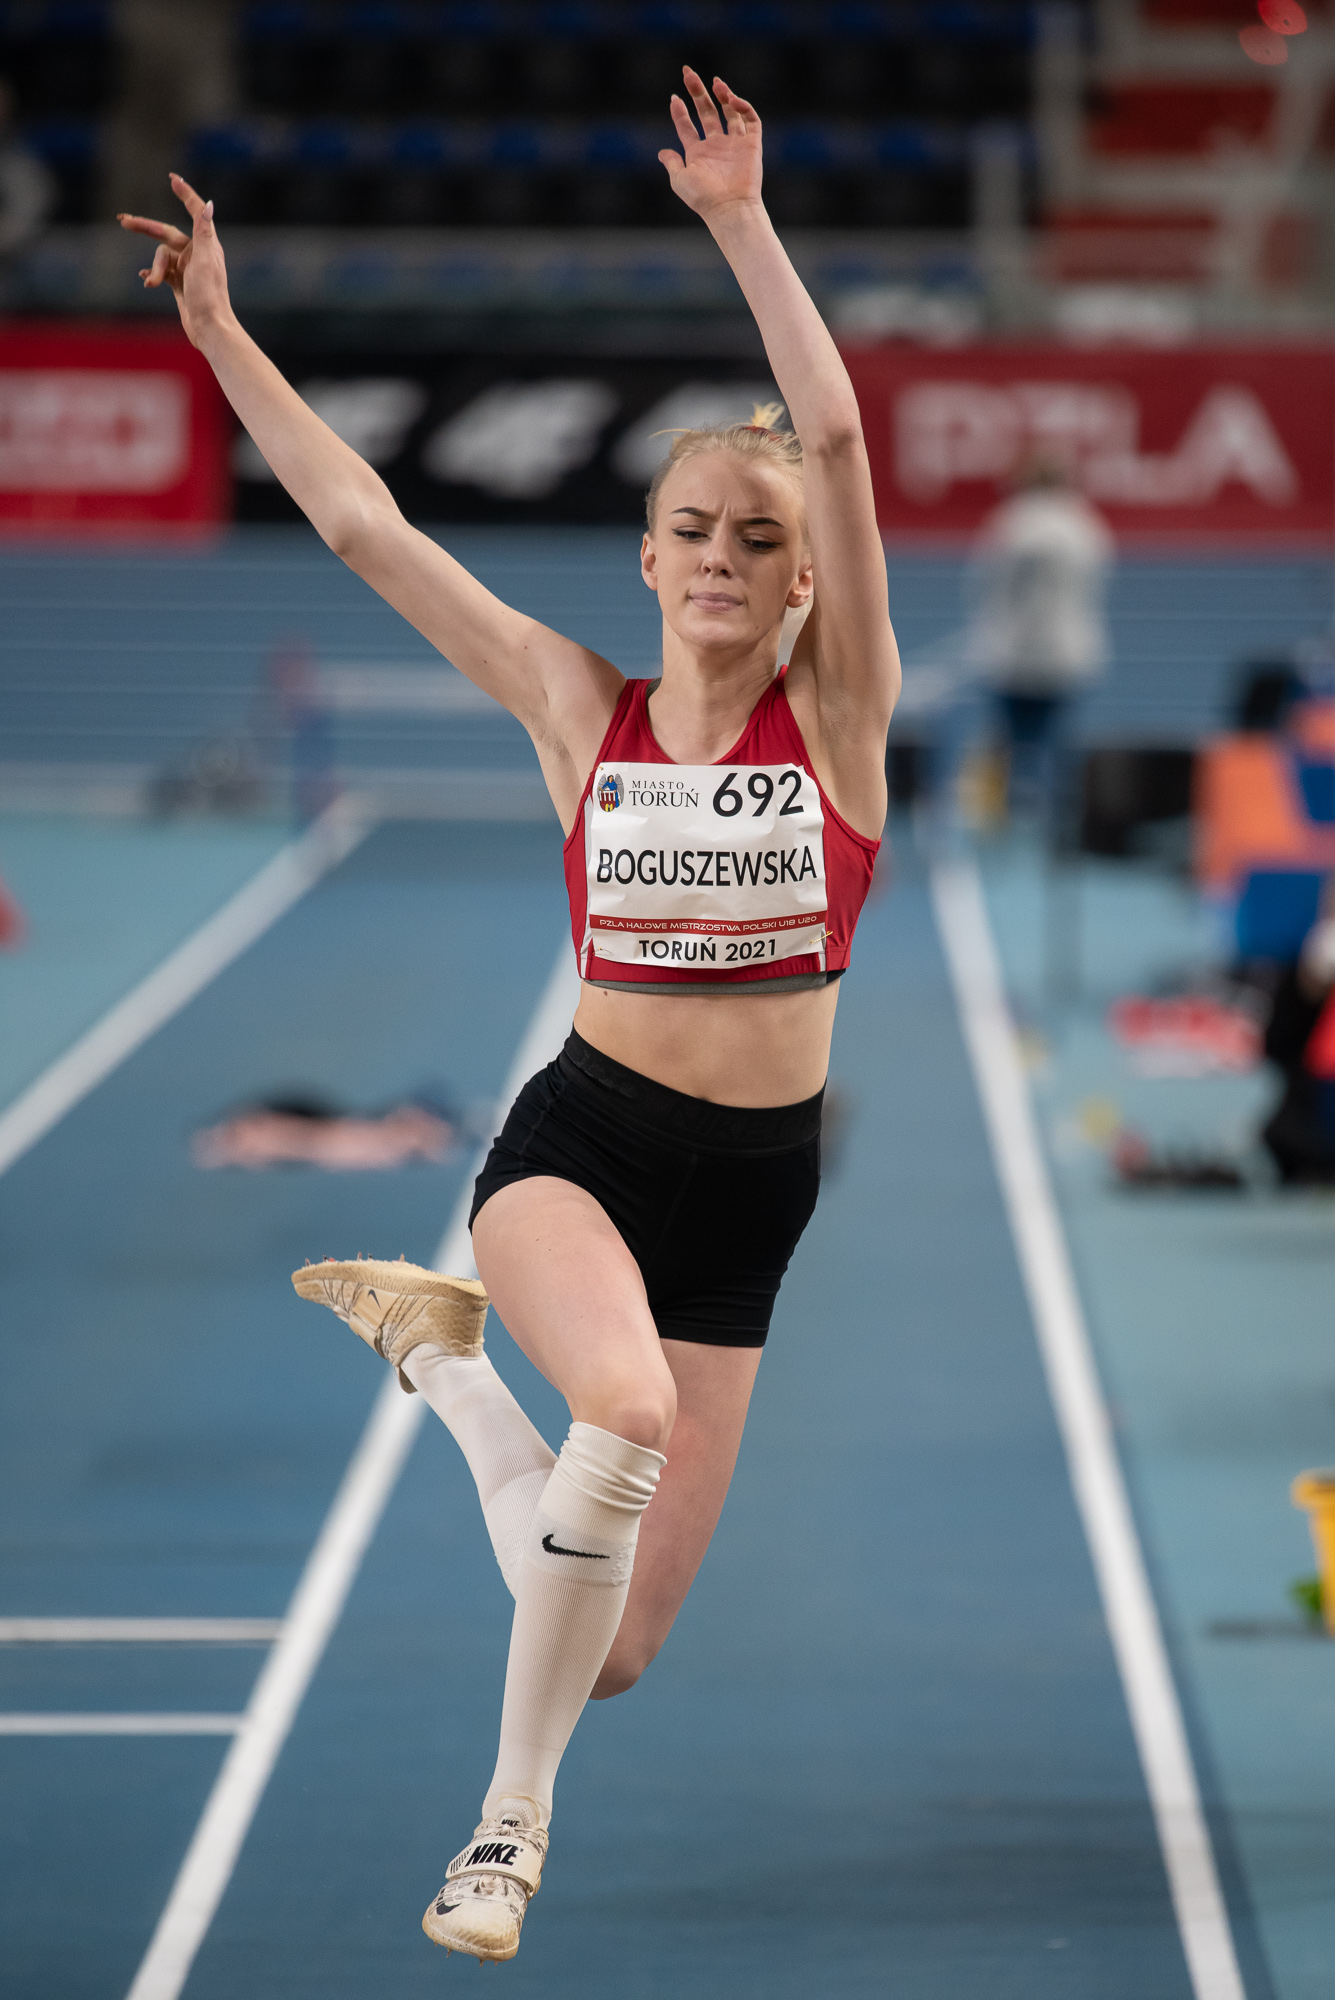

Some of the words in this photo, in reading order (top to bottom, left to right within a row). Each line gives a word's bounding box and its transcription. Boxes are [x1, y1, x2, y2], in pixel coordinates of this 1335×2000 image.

[628, 788, 700, 808] TORUŃ
[631, 780, 685, 790] MIASTO
[712, 770, 804, 818] 692
[596, 845, 818, 887] BOGUSZEWSKA
[599, 918, 625, 929] PZLA
[626, 921, 668, 930] HALOWE
[669, 922, 741, 932] MISTRZOSTWA
[742, 921, 777, 932] POLSKI
[778, 919, 796, 927] U18
[797, 915, 818, 925] U20
[638, 936, 716, 962] TORUŃ
[725, 938, 776, 962] 2021
[464, 1842, 519, 1868] NIKE
